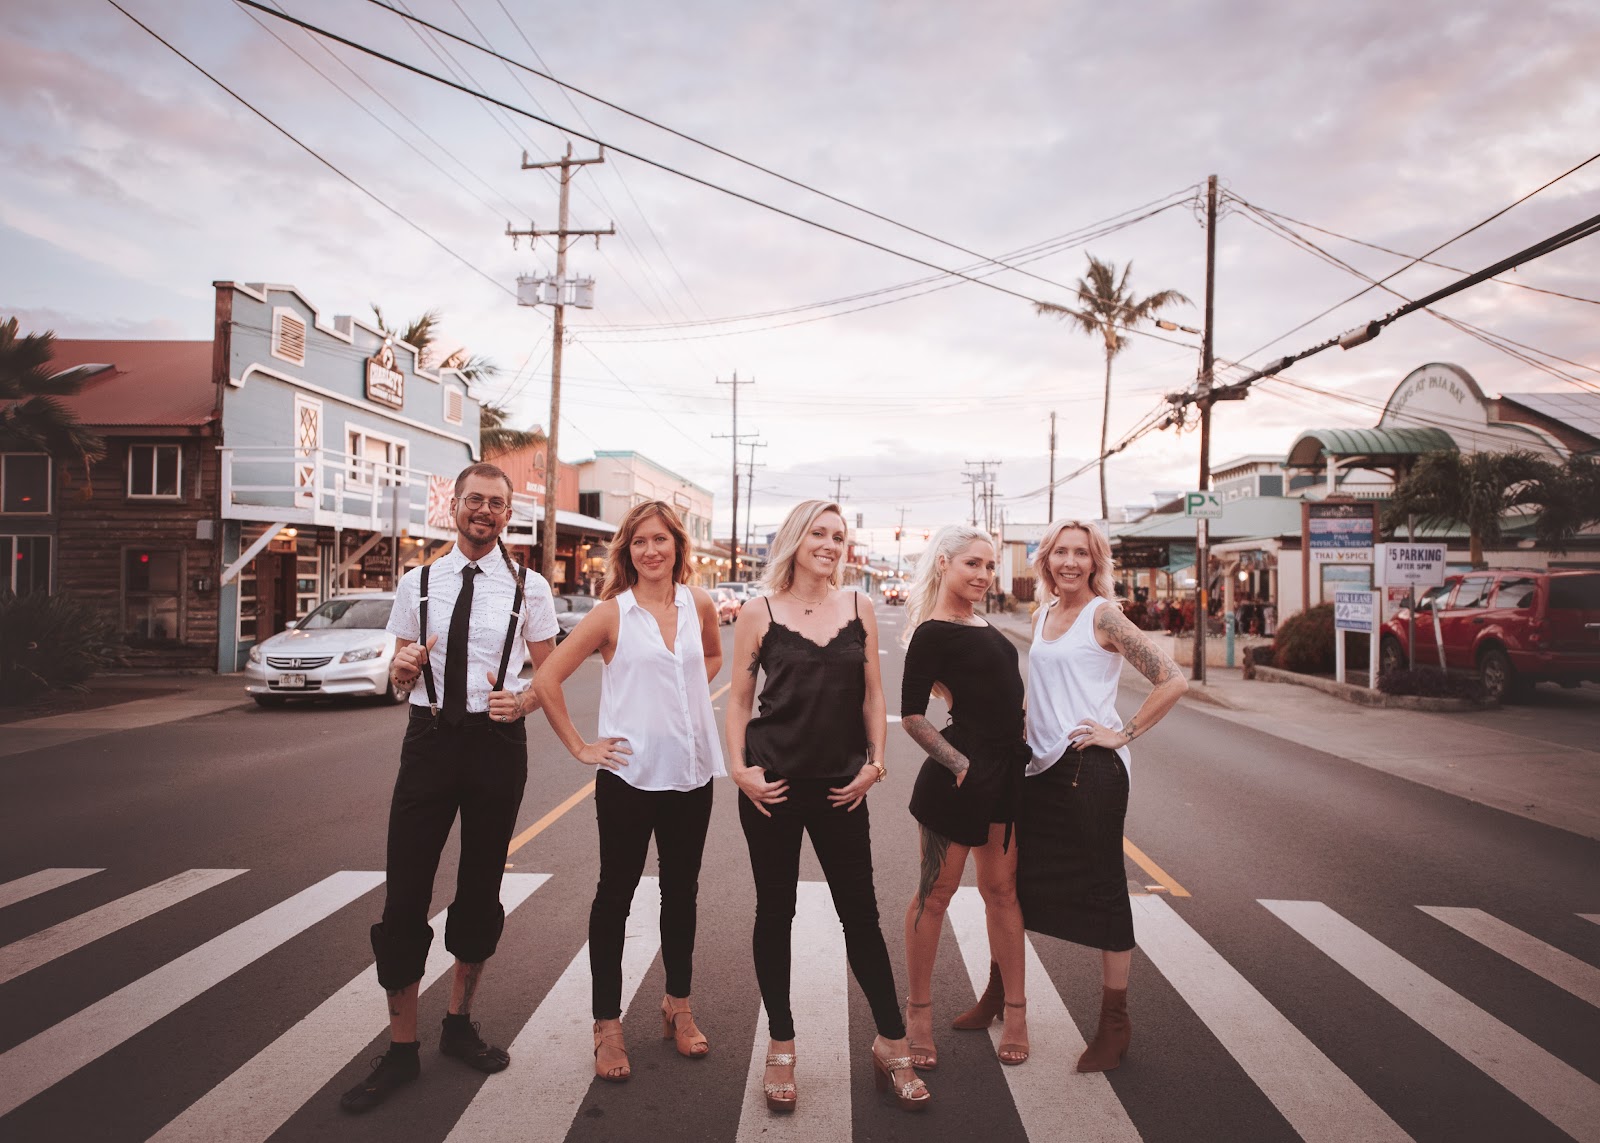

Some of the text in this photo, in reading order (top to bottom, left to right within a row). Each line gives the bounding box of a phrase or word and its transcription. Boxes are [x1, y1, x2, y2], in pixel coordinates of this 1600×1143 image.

[1415, 378, 1426, 392] AT
[1429, 376, 1448, 390] PAIA
[1449, 381, 1466, 404] BAY
[1188, 494, 1221, 516] PARKING
[1345, 552, 1369, 560] SPICE
[1400, 549, 1442, 561] PARKING
[1336, 594, 1372, 604] FOR LEASE
